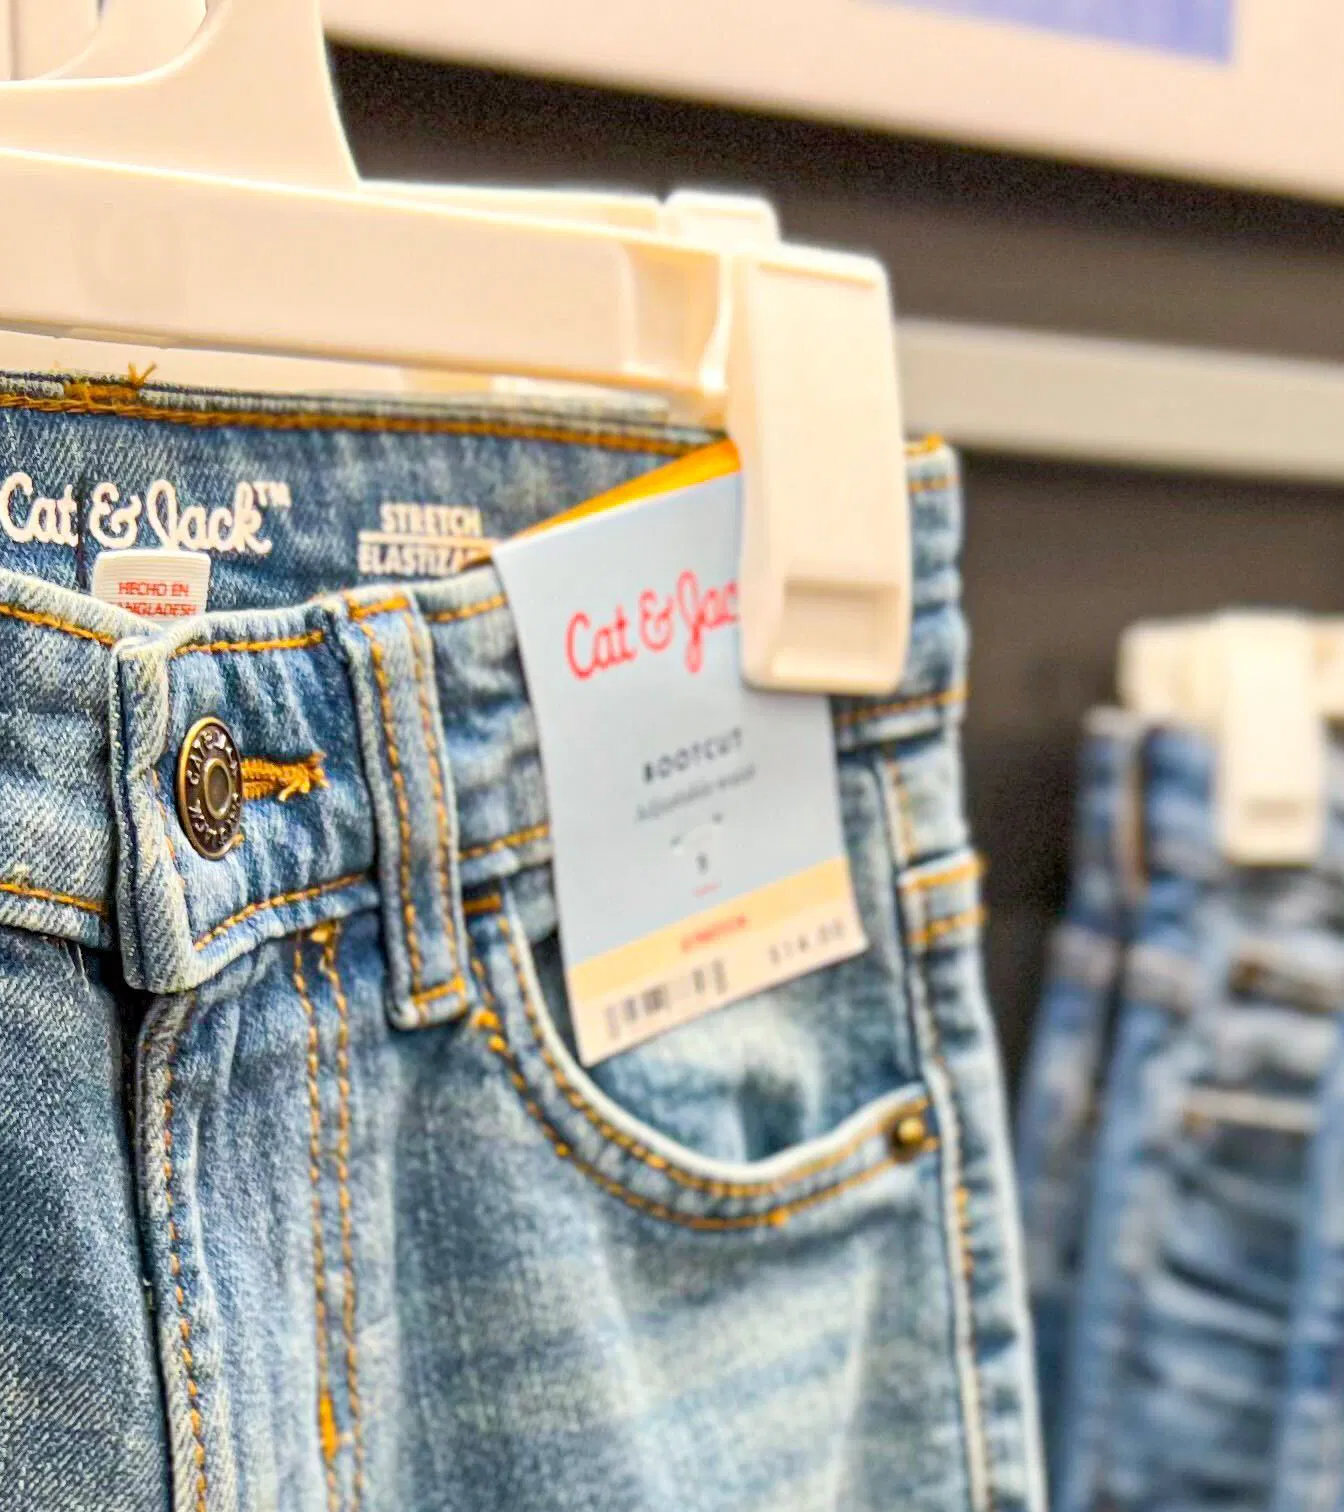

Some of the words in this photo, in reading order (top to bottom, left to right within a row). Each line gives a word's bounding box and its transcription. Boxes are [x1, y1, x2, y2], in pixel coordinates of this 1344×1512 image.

[89, 482, 142, 549] &
[379, 502, 483, 537] STRETCH
[358, 542, 488, 577] ELASTIZA
[118, 582, 168, 596] HECHO
[171, 583, 189, 597] EN
[119, 602, 197, 616] ANGLADESH
[564, 604, 637, 681] Cat
[639, 588, 674, 651] &
[676, 569, 739, 675] Jac
